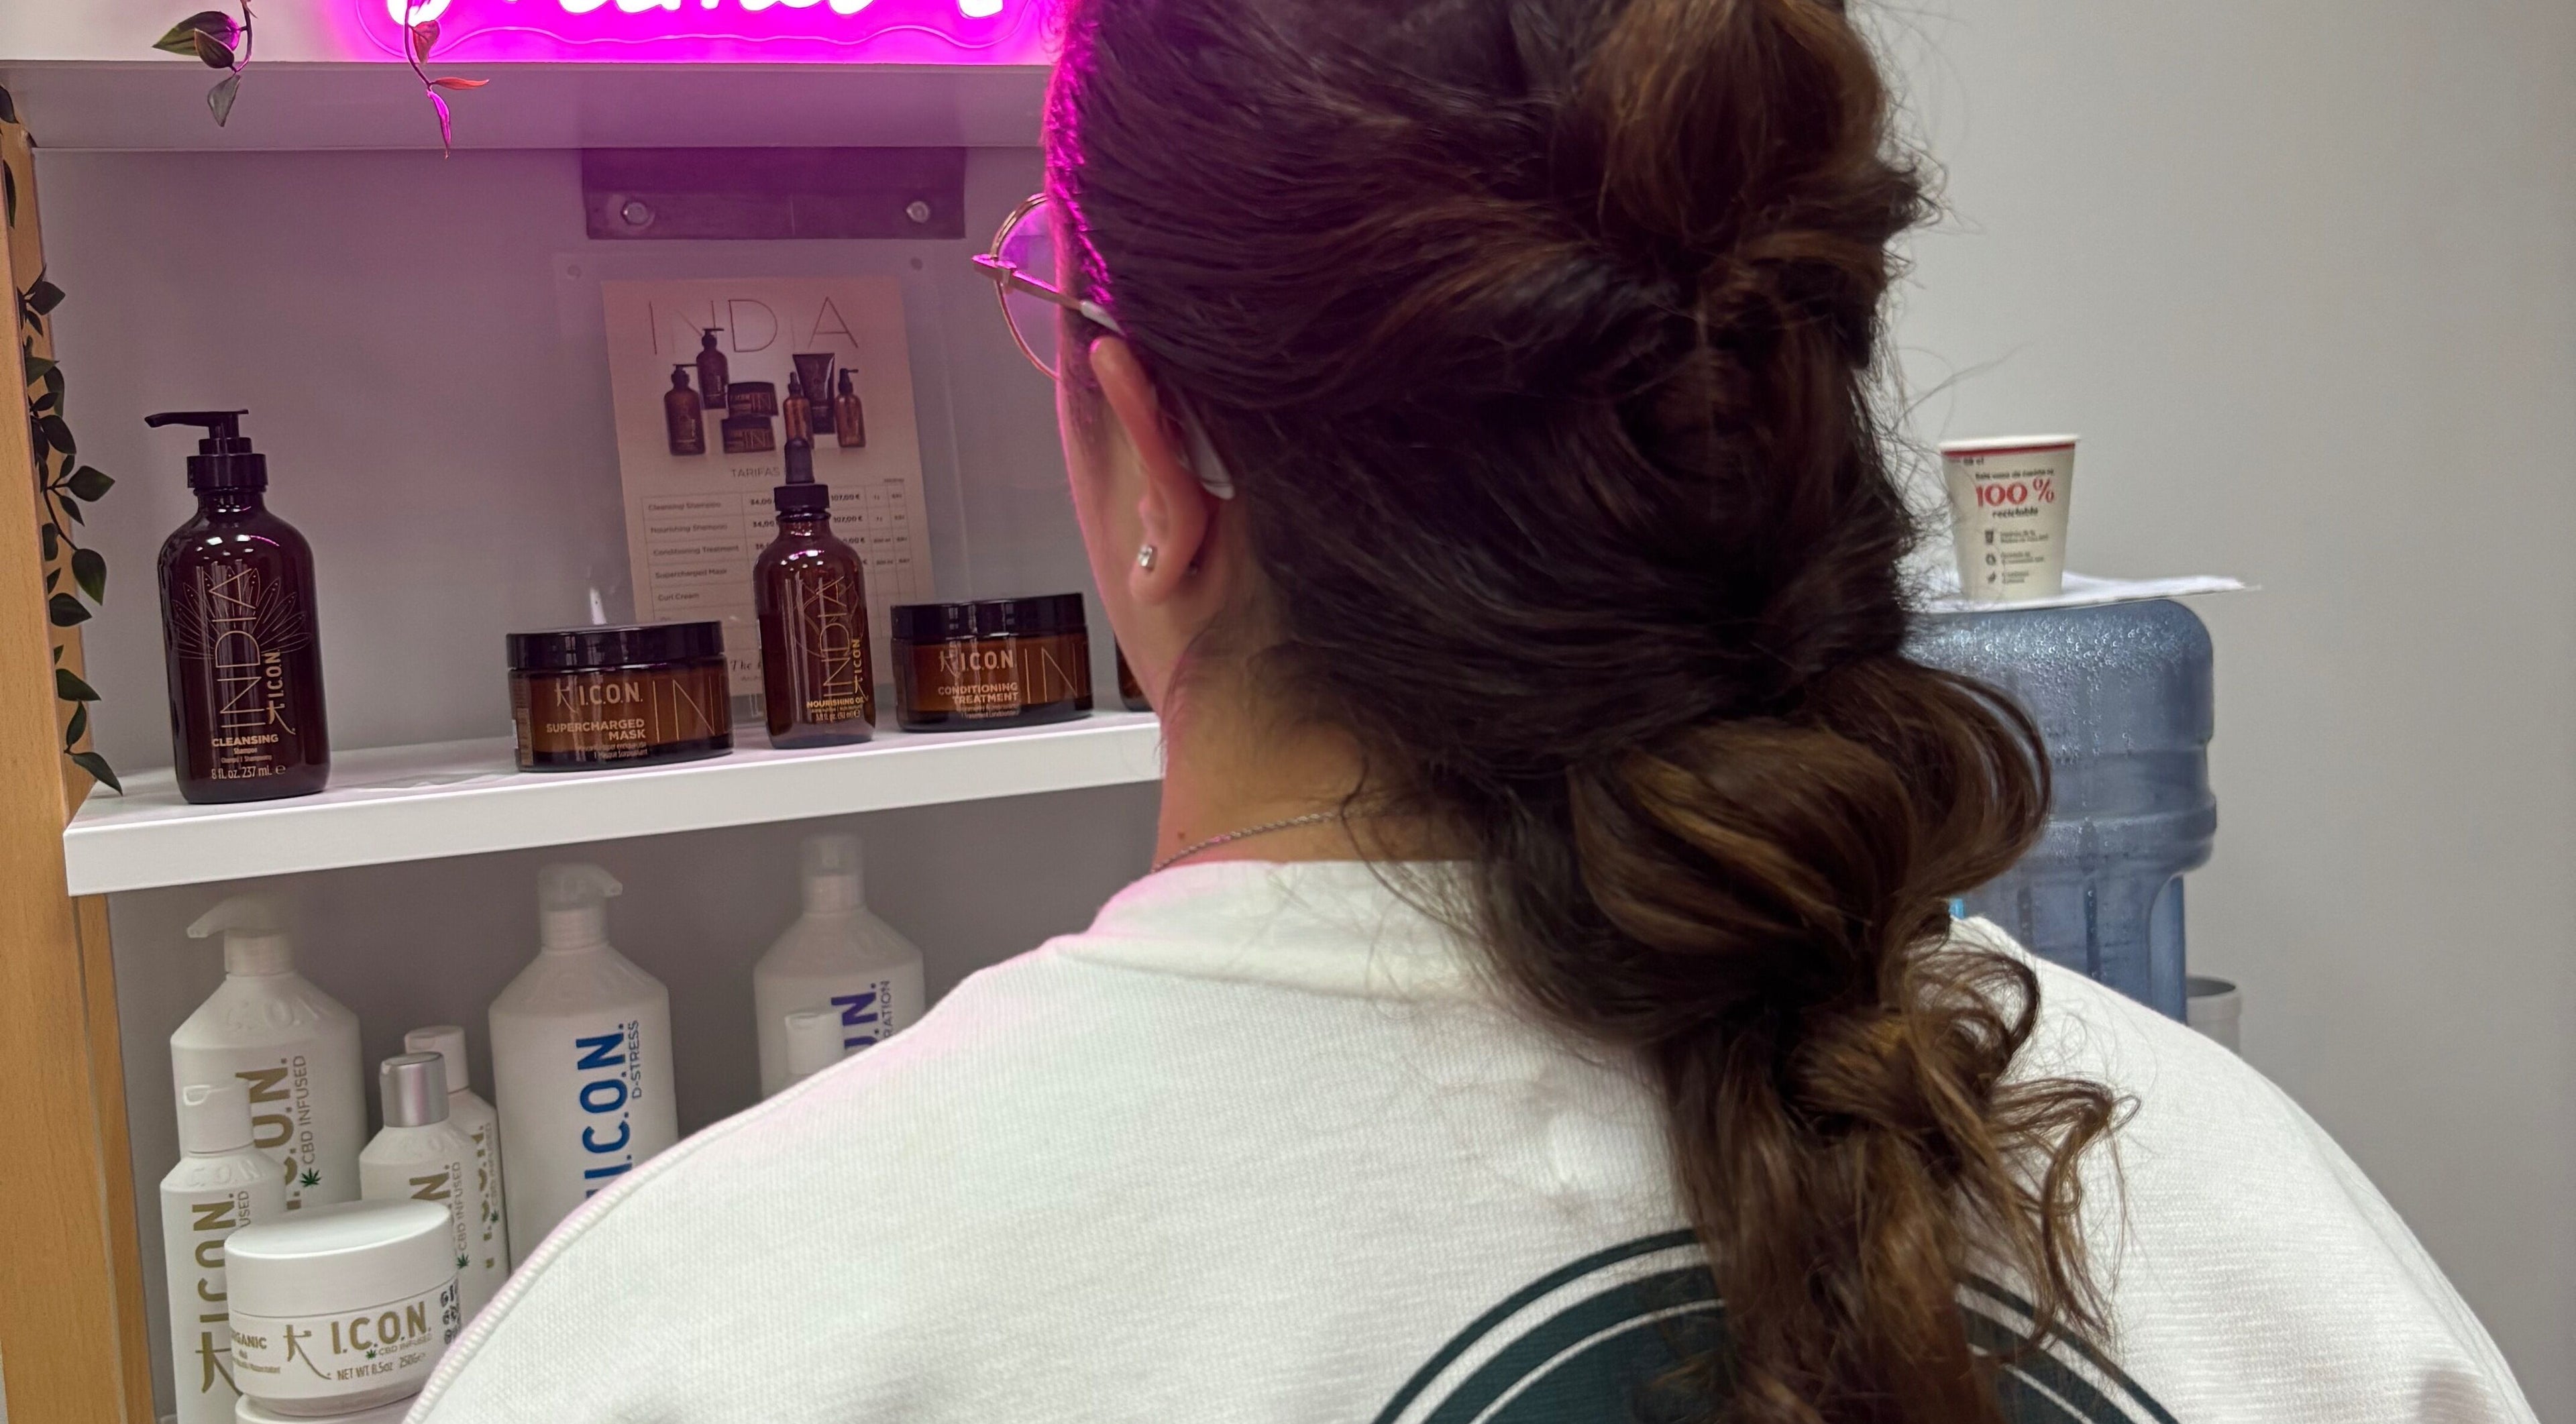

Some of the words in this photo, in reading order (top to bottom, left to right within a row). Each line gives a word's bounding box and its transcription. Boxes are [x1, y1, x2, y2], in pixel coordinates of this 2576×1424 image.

[731, 467, 781, 478] TARIFAS
[1976, 482, 2028, 508] 100
[817, 576, 853, 697] INDIA
[208, 568, 266, 728] INDIA
[938, 681, 1018, 696] CONDITIONING
[952, 692, 1019, 704] TREATMENT
[806, 698, 855, 709] NOURISHING
[546, 718, 645, 732] SUPERCHARGED
[608, 728, 646, 741] MASK
[211, 734, 279, 747] CLEANSING
[241, 765, 256, 778] 237
[628, 1020, 640, 1099] D-STRESS
[292, 1055, 312, 1126] INFUSED
[576, 1023, 633, 1179] I.C.O.N.
[301, 1130, 315, 1165] CBD
[451, 1161, 464, 1221] INFUSED
[456, 1222, 468, 1252] CBD
[331, 1301, 432, 1355] I.C.O.N.
[378, 1345, 398, 1356] CBD
[337, 1368, 354, 1381] NET
